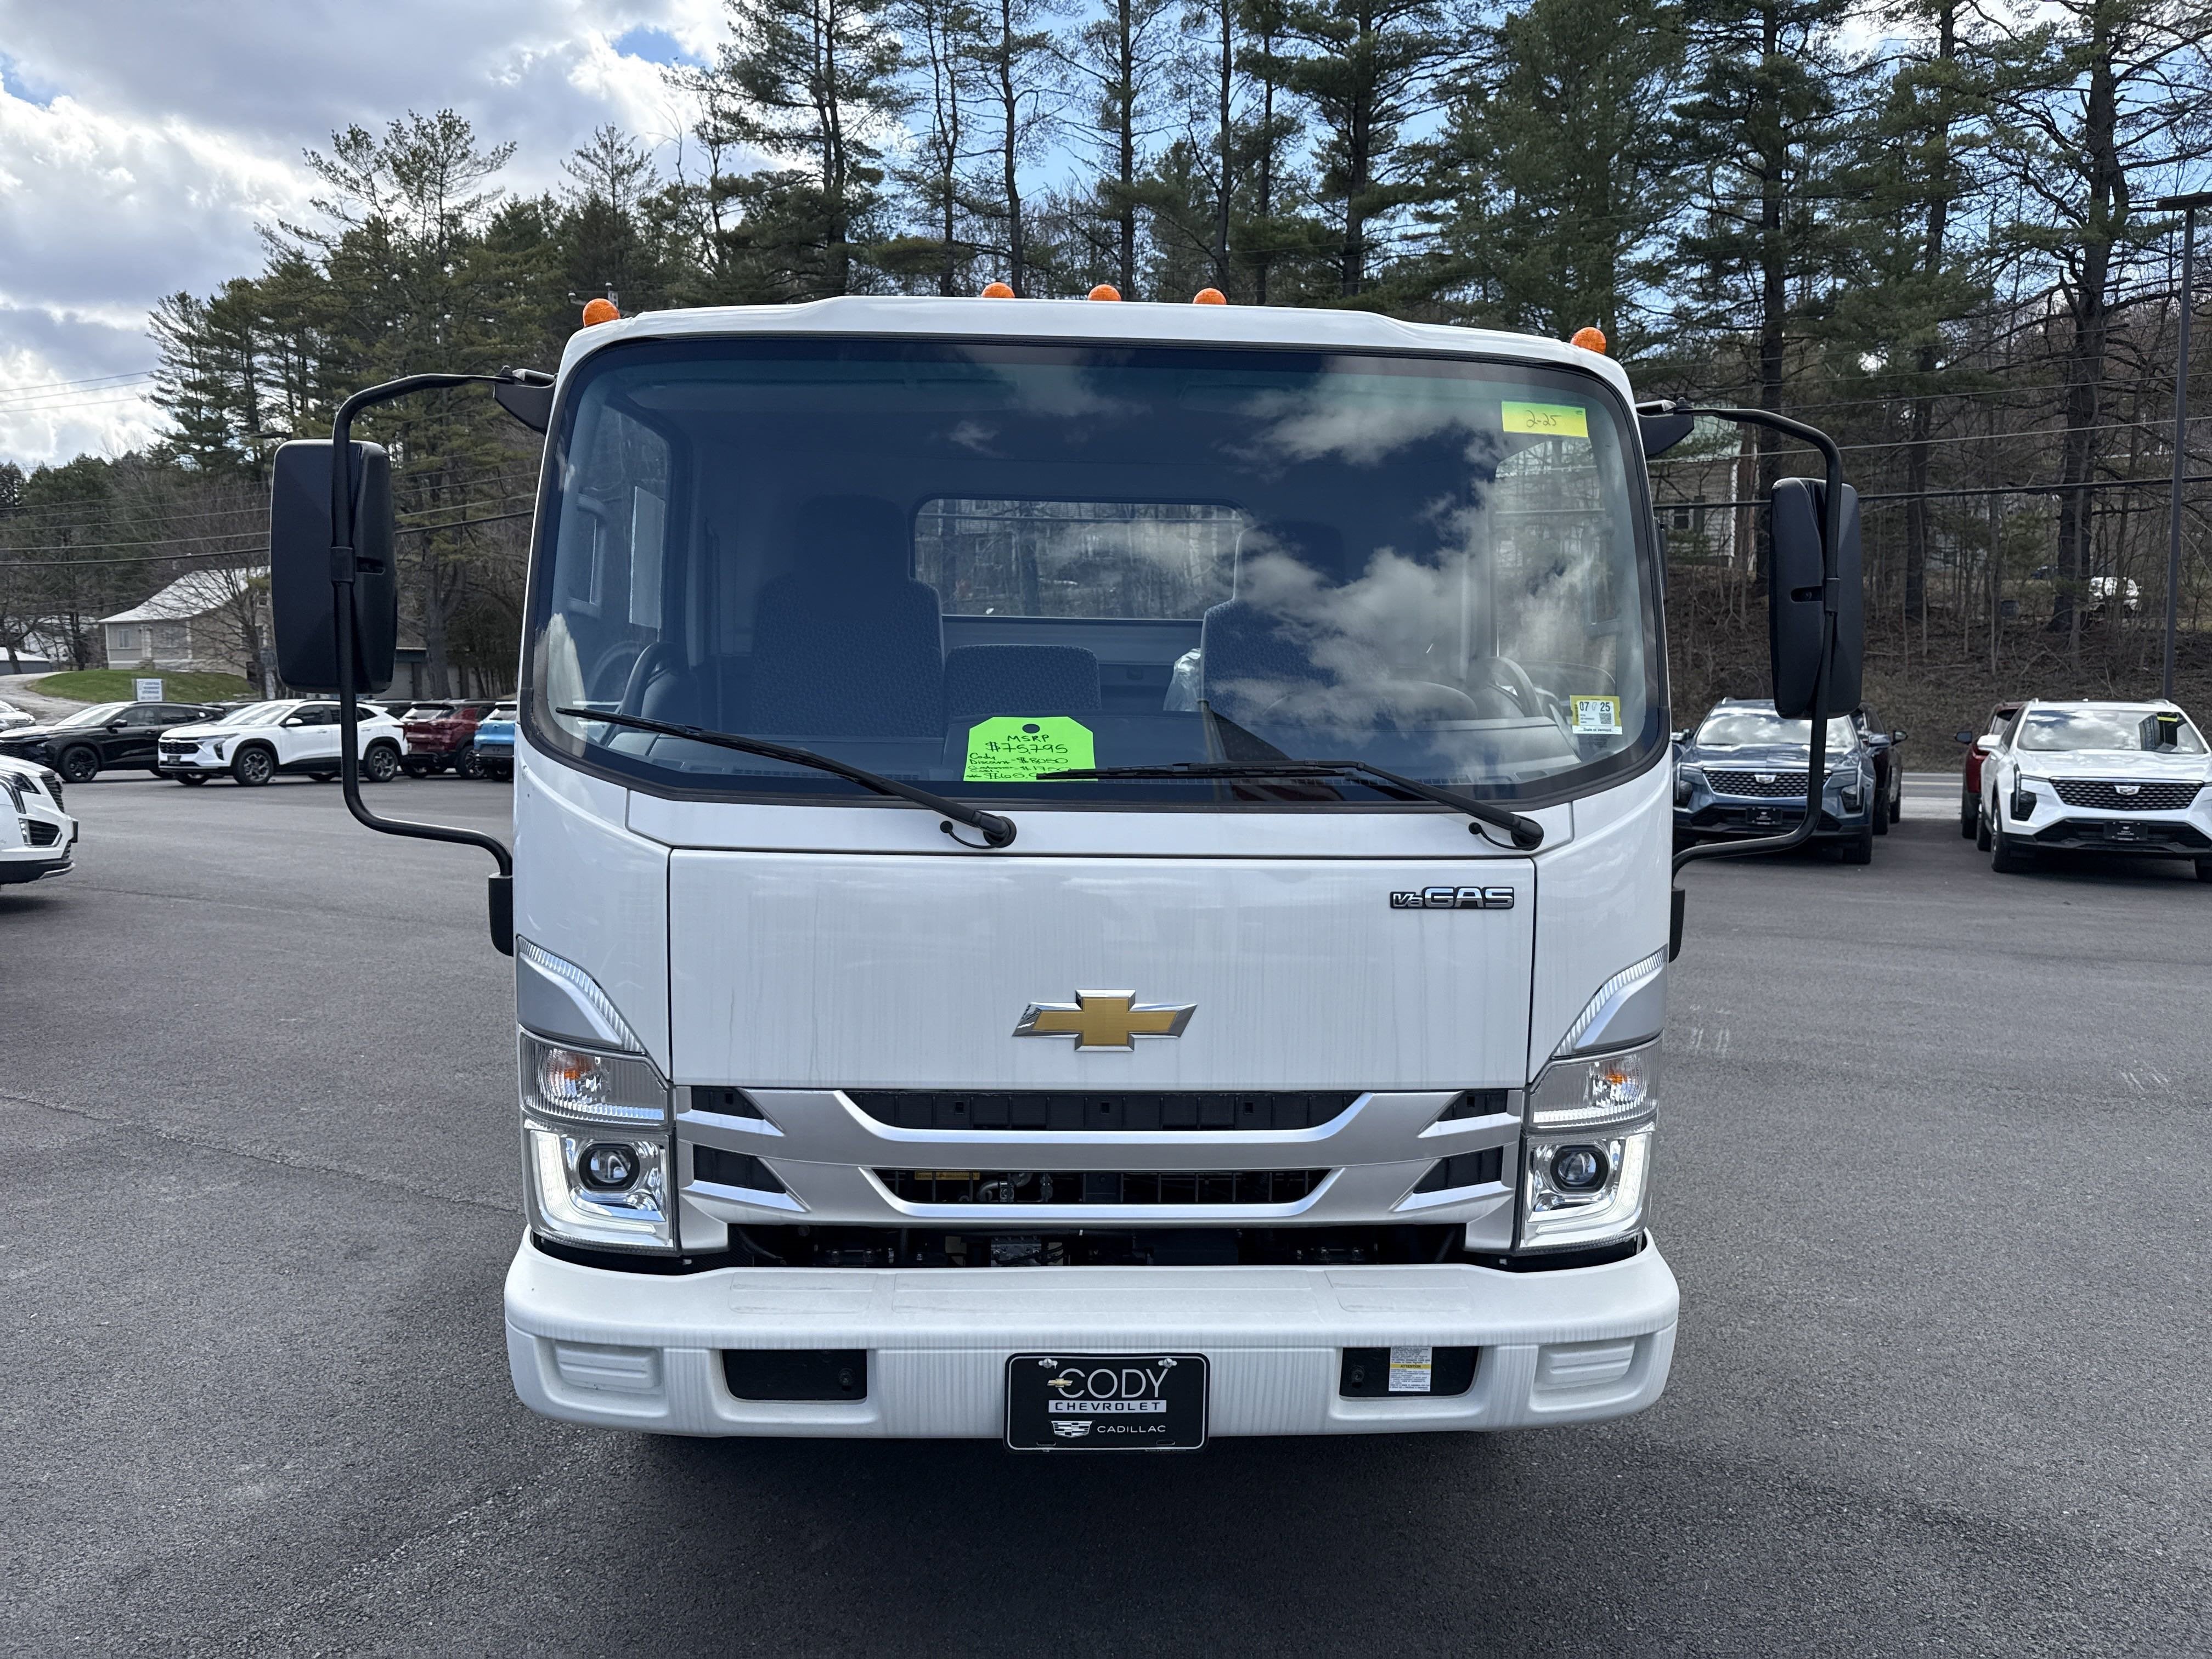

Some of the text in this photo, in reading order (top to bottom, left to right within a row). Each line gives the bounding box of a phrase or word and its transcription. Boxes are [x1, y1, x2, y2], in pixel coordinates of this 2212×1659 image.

[1526, 410, 1562, 428] 2-25
[1579, 701, 1610, 712] 07 25
[1007, 734, 1049, 742] MSRP
[985, 741, 1068, 754] $75,795
[969, 752, 996, 761] Cody
[1423, 887, 1514, 909] GAS
[1057, 1368, 1169, 1398] CODY
[1054, 1402, 1161, 1412] CHEVROLET
[1097, 1425, 1167, 1434] CADILLAC
